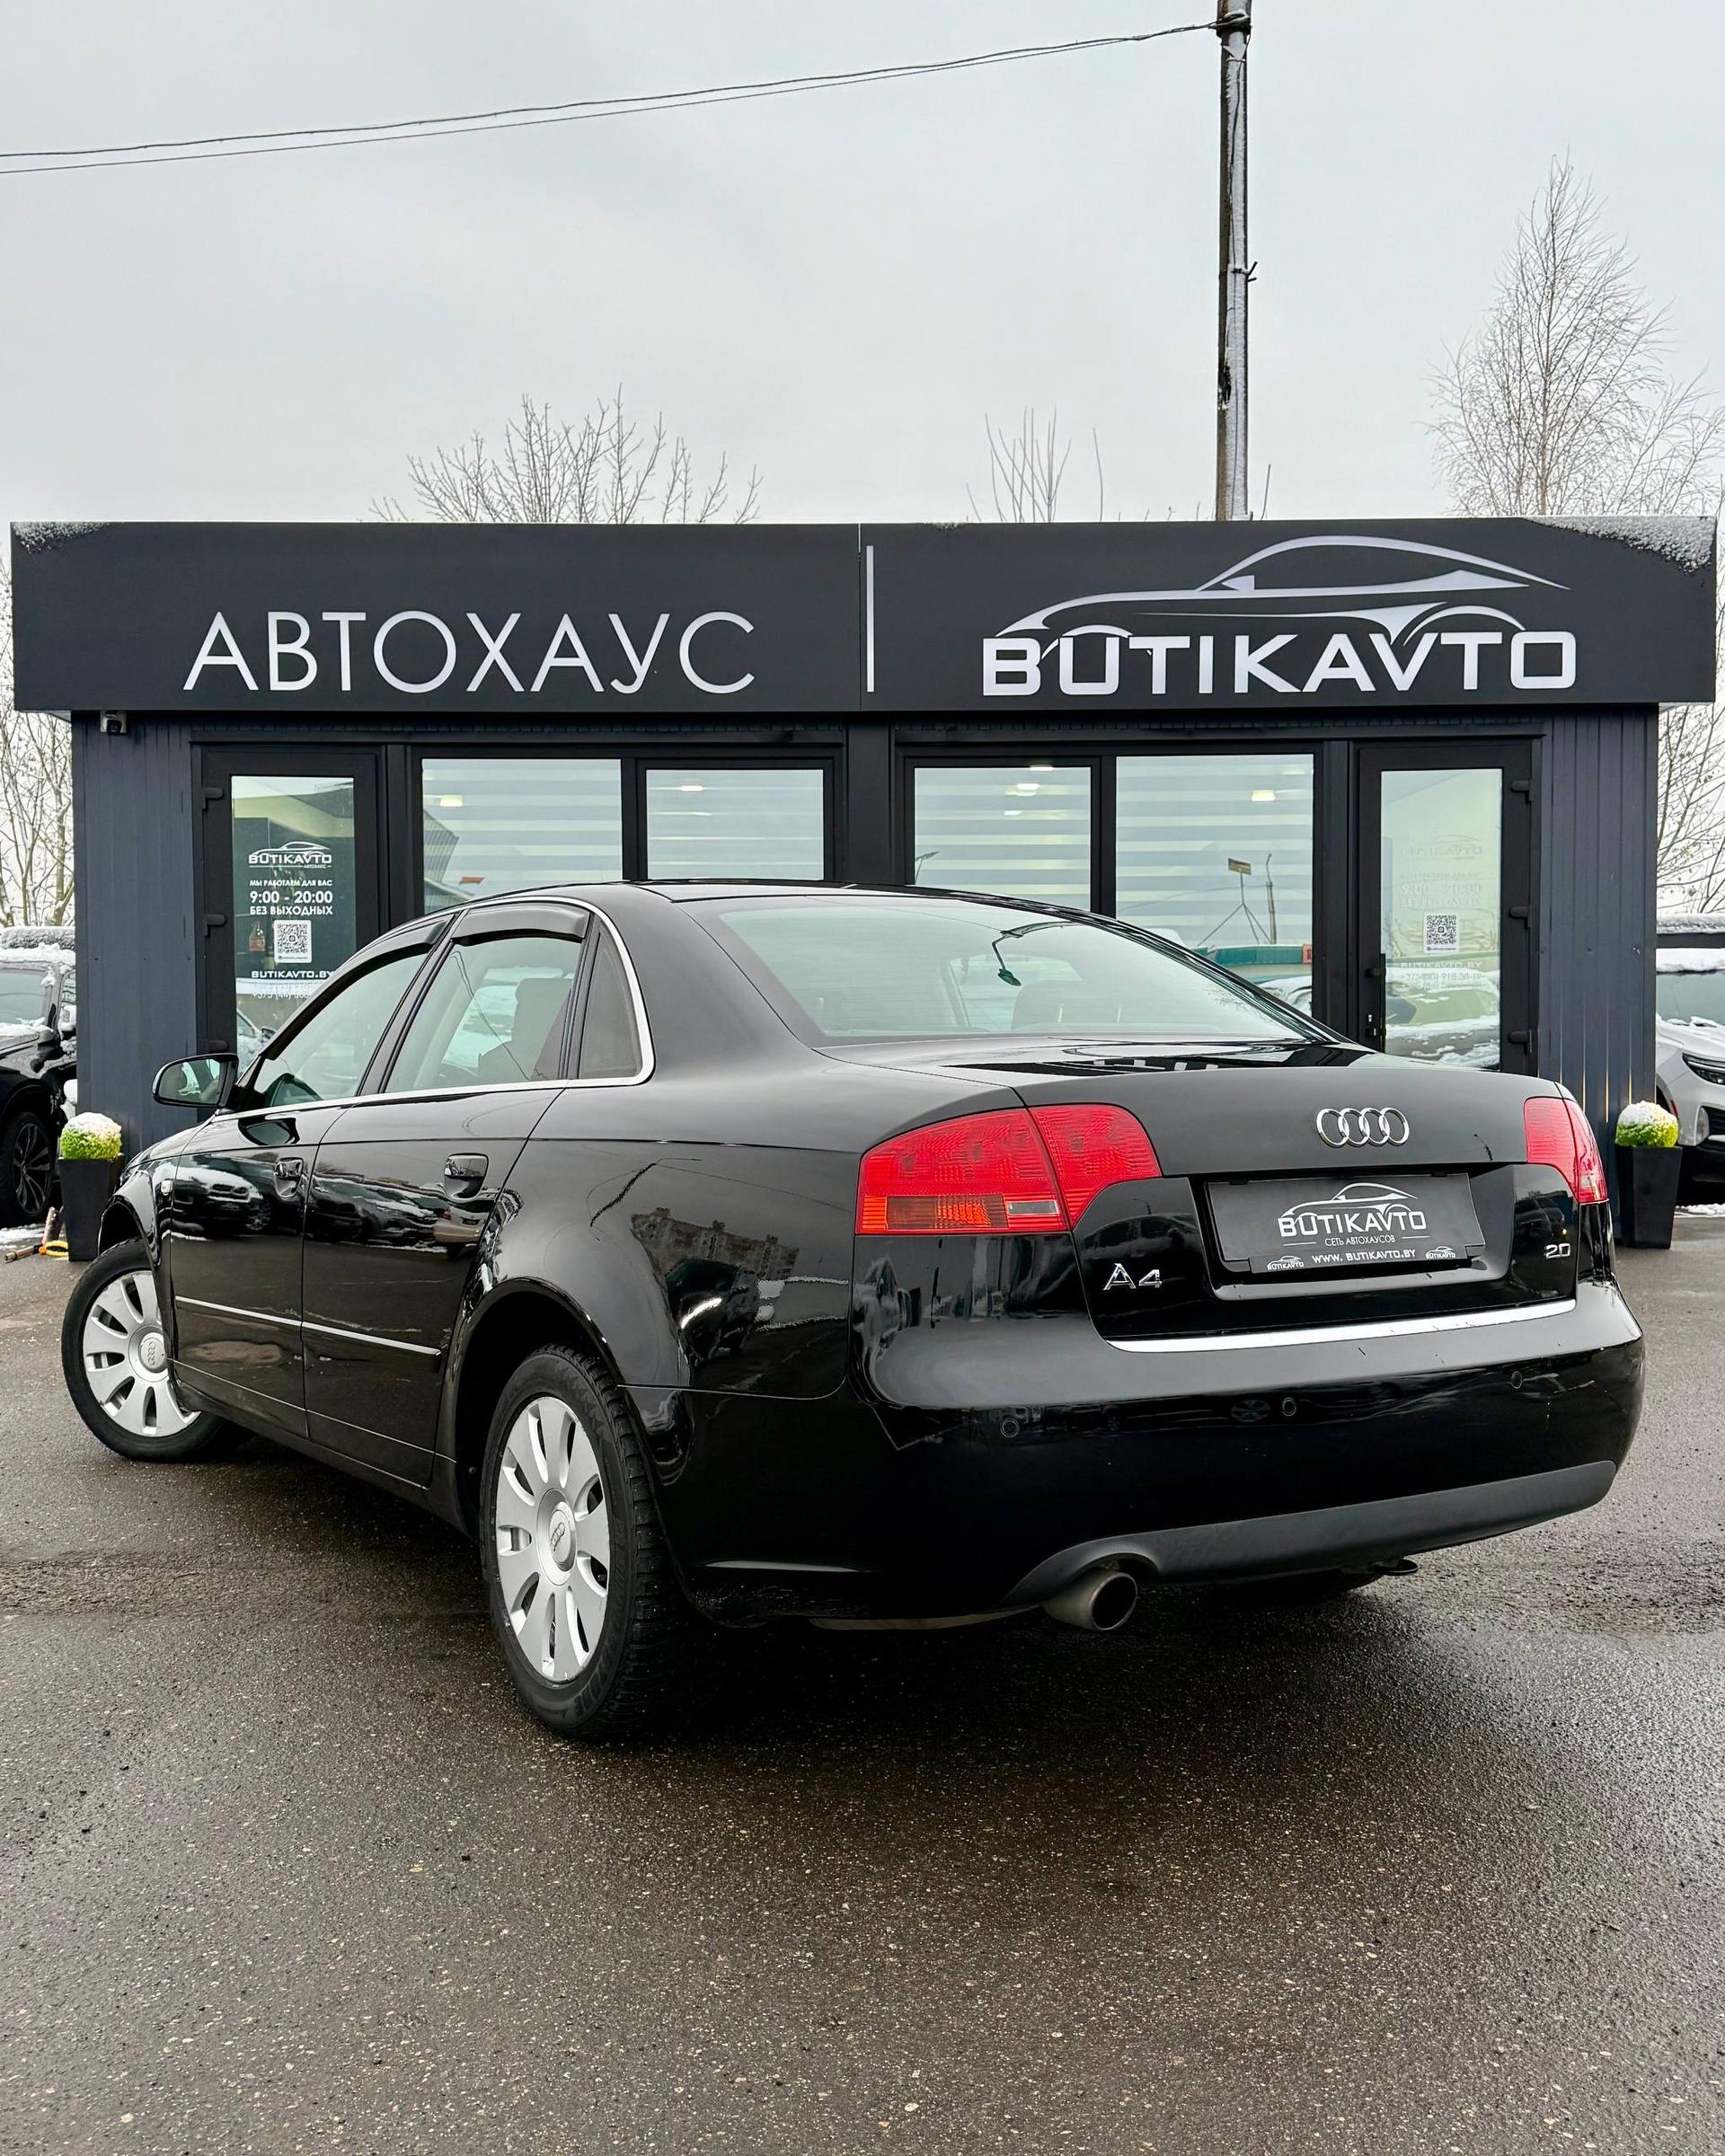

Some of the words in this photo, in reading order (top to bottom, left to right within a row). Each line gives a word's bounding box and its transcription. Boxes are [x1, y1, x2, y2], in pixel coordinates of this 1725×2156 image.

[182, 610, 755, 695] АВТОХАУС
[982, 630, 1578, 697] BUTIKAVTO
[249, 853, 332, 864] BUTIKAVTO
[263, 879, 301, 888] РАБОТАЕМ
[302, 879, 316, 888] ДЛЯ
[317, 879, 333, 888] ВАС
[250, 890, 280, 904] 9:00
[294, 890, 333, 904] 20:00
[250, 906, 268, 915] БЕЗ
[270, 906, 333, 916] ВЫХОДНЫХ
[252, 970, 334, 978] BUTIKAVTO.BY
[1278, 1210, 1428, 1238] BUTIKAVTO
[1324, 1236, 1345, 1247] СЕТЬ
[1346, 1234, 1396, 1245] АВТОХАУСОВ
[1312, 1253, 1343, 1265] WWW.
[1345, 1249, 1417, 1262] BUTIKAVTO.BY
[1266, 1259, 1305, 1271] BUTIKAVTO
[1102, 1262, 1163, 1291] A4
